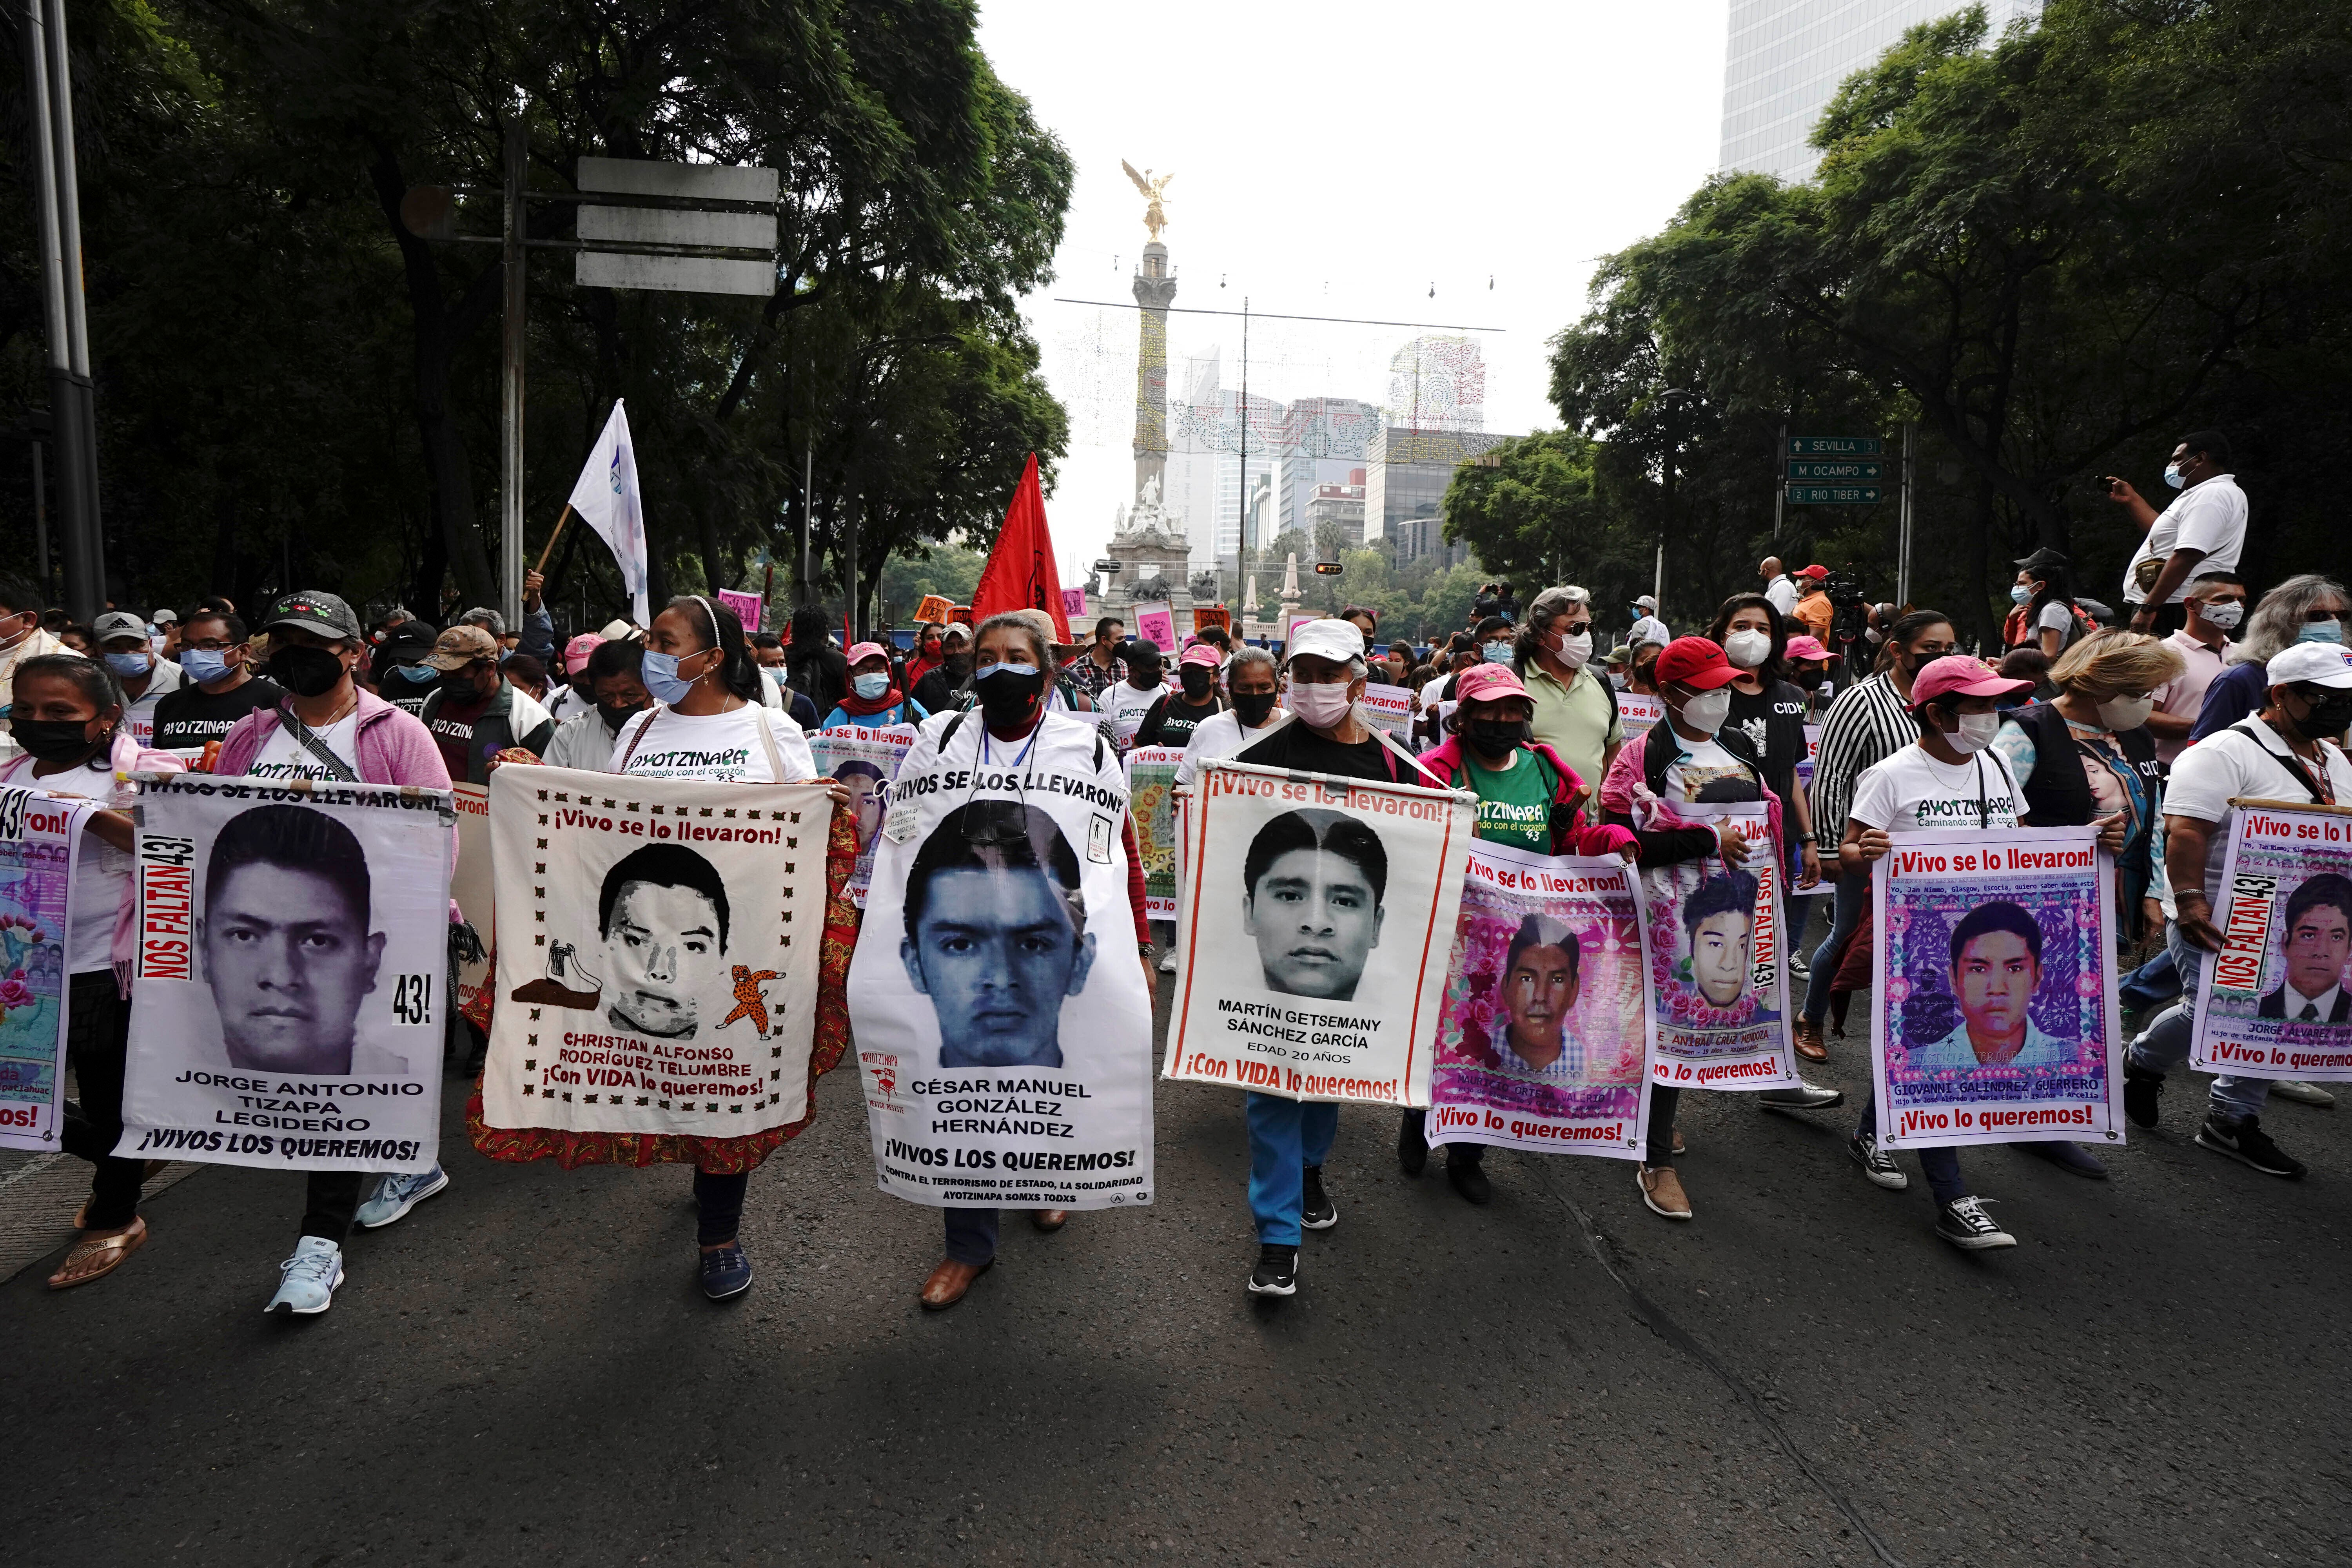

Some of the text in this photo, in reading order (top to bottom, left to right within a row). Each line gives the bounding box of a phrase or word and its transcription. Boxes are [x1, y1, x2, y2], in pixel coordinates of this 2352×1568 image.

[1813, 441, 1855, 451] SEVILLA
[1799, 466, 1859, 475] M OCAMPO
[1812, 490, 1828, 499] RIO
[1833, 490, 1859, 499] TIBER
[278, 597, 332, 613] AYOTZINAPA
[1632, 706, 1660, 717] se lo
[1774, 702, 1806, 714] CIDH
[837, 728, 867, 740] se lo
[1120, 736, 1129, 746] lo
[630, 748, 746, 768] AYOTZINAPA
[1134, 750, 1166, 764] ¡Vivo
[709, 766, 746, 777] corazón
[942, 771, 971, 790] SE
[1726, 766, 1746, 774] DONDE
[1212, 772, 1307, 801] ¡Vivo se
[555, 809, 781, 844] ¡Vivo se lo llevaron!
[1510, 822, 1517, 831] el
[1519, 822, 1547, 832] corazón
[1918, 818, 1967, 828] Caminando
[2245, 815, 2339, 841] ¡Vivo se lo
[142, 835, 194, 866] 43!
[1892, 845, 2094, 877] ¡Vivo se lo llevaron!
[1498, 869, 1626, 893] se lo llevaron!
[1757, 867, 1772, 900] NOS
[1924, 885, 1947, 894] Nimmo,
[1951, 886, 1980, 894] Glasgow,
[2232, 873, 2278, 898] 43!
[146, 865, 190, 935] FALTAN
[1755, 904, 1773, 964] FALTAN
[2223, 897, 2269, 954] FALTAN
[144, 939, 189, 980] NOS
[1754, 964, 1775, 989] 43!
[2216, 955, 2259, 989] NOS
[393, 973, 431, 1025] 43!
[1218, 999, 1381, 1032] MARTÍN GETSEMANY
[1227, 1018, 1368, 1049] SÁNCHEZ GARCÍA
[1715, 1035, 1738, 1045] CRUZ
[2242, 1034, 2272, 1043] Epifanio
[2248, 1023, 2351, 1038] JORGE NAVA
[563, 1032, 733, 1060] CHRISTIAN ALFONSO
[1247, 1042, 1351, 1064] EDAD 20 AÑOS
[1670, 1047, 1695, 1055] Carmen
[2211, 1041, 2286, 1065] ¡Vivo lo
[559, 1047, 751, 1077] RODRÍGUEZ TELUMBRE
[884, 1068, 895, 1077] 43
[1185, 1053, 1280, 1089] ¡Con VIDA
[1674, 1056, 1778, 1085] lo queremos!
[175, 1070, 424, 1097] JORGE ANTONIO
[543, 1064, 764, 1098] ¡Con VIDA lo queremos!
[912, 1078, 1092, 1098] CÉSAR MANUEL
[1894, 1078, 2099, 1096] GIOVANNI GALINDREZ GUERRERO
[237, 1096, 342, 1114] TIZAPA
[2067, 1091, 2099, 1099] Arcelia
[937, 1097, 1062, 1117] GONZÁLEZ
[216, 1110, 370, 1132] LEGIDEÑO
[932, 1118, 1074, 1138] HERNÁNDEZ
[1436, 1107, 1622, 1142] ¡Vivo lo queremos!
[1900, 1105, 2093, 1136] ¡Vivo lo queremos!
[136, 1128, 420, 1161] ¡VIVOS LOS QUEREMOS!
[885, 1138, 1136, 1171] ¡VIVOS LOS QUEREMOS!
[885, 1164, 1143, 1191] CONTRA EL TERRORISMO DE ESTADO, LA SOLIDARIDAD
[943, 1191, 1076, 1203] AYOTZINAPA SOMXS TODXS
